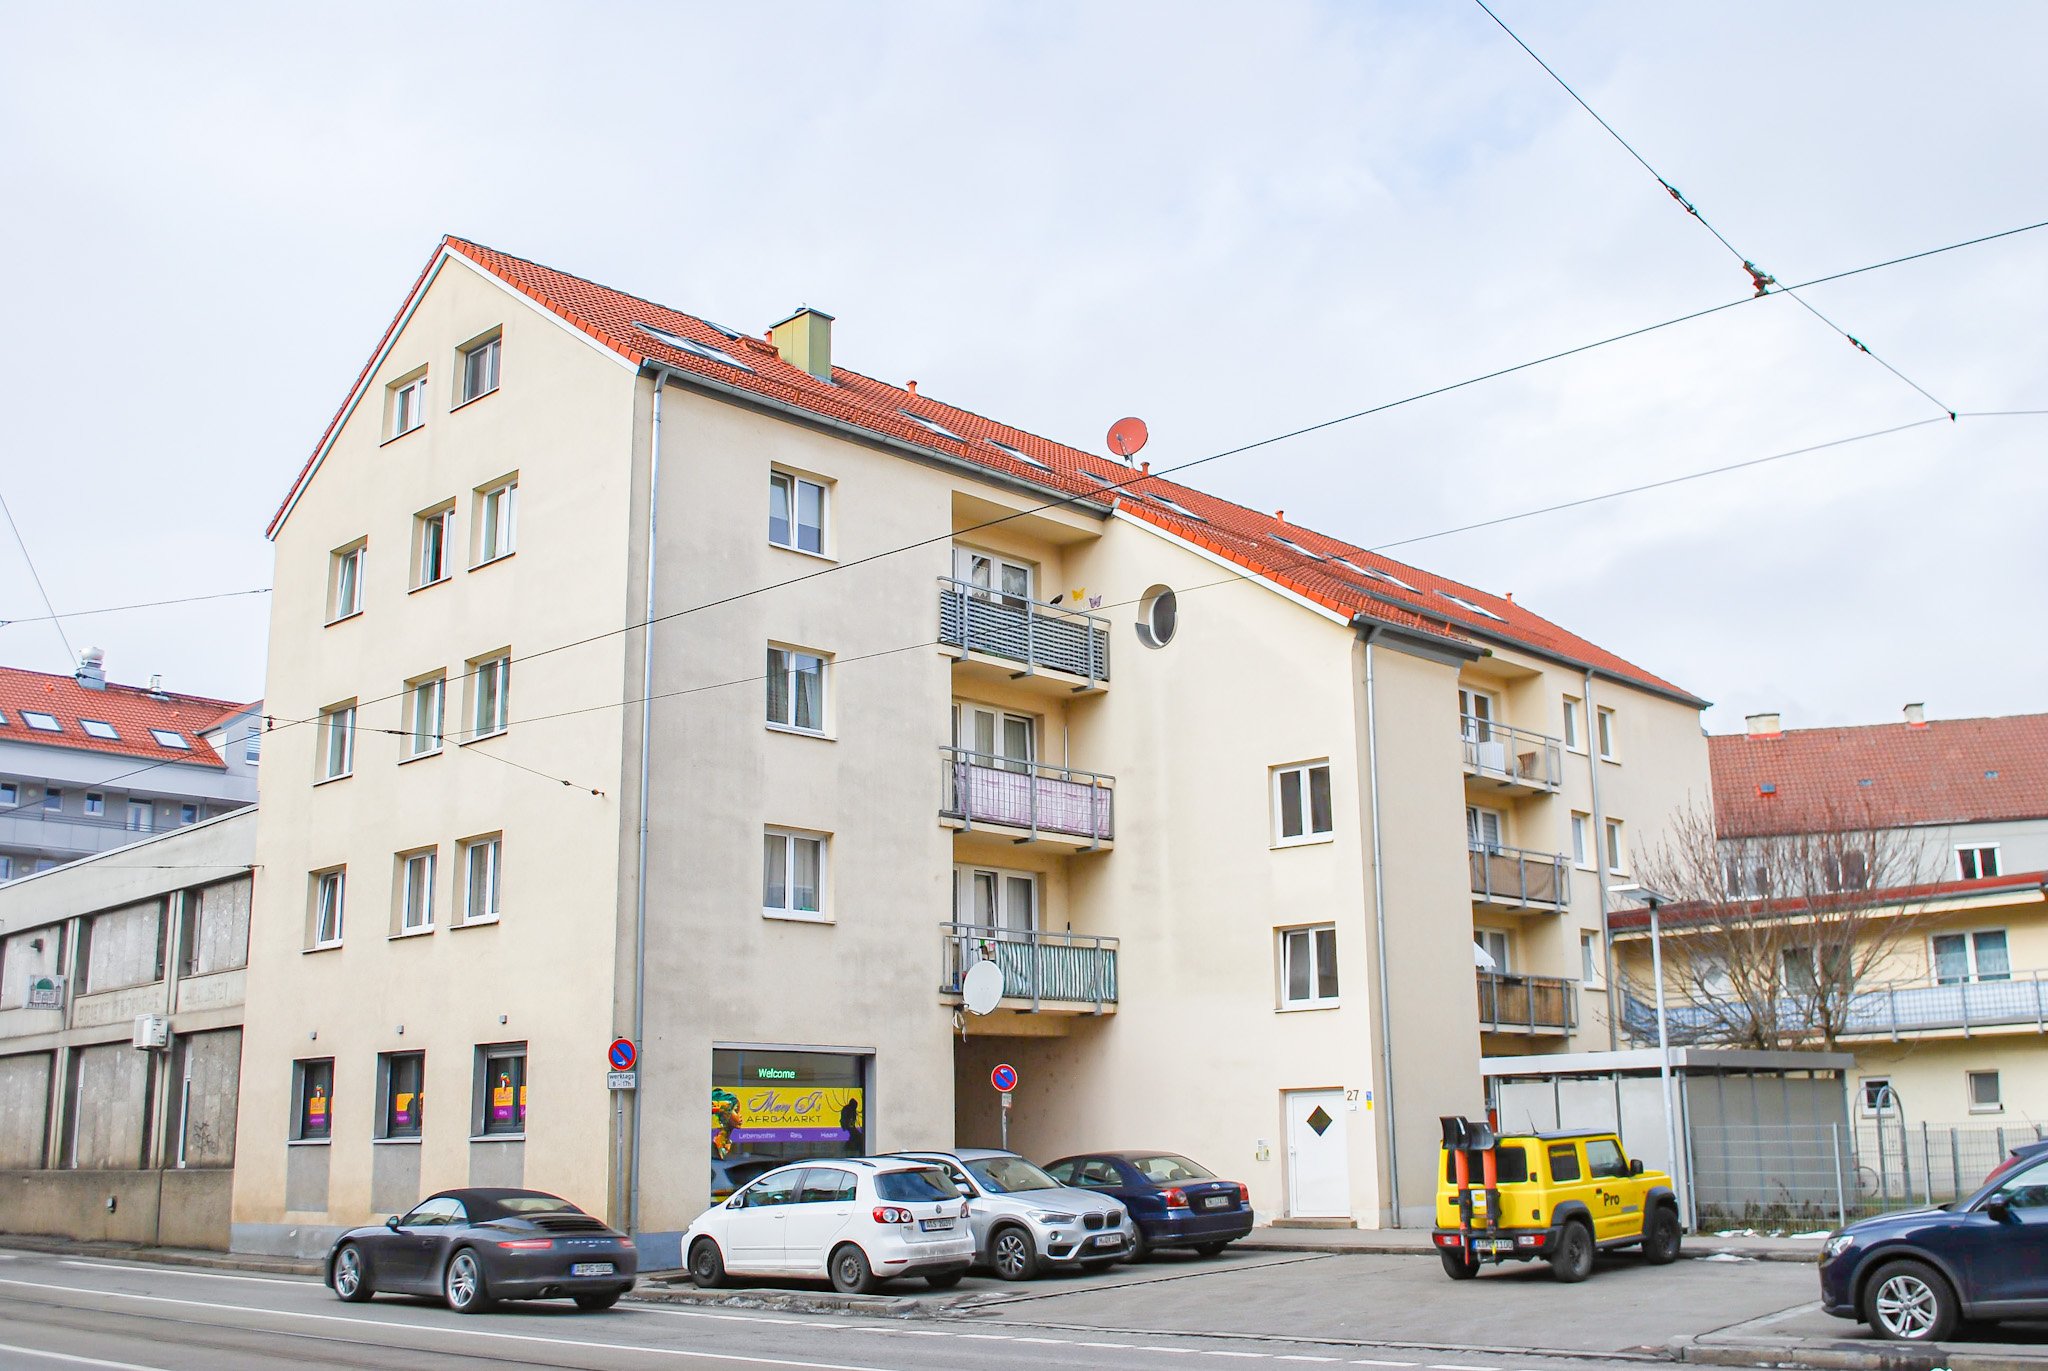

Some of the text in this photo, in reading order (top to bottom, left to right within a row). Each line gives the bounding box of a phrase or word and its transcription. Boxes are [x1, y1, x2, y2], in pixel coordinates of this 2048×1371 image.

[758, 1068, 796, 1079] Welcome
[1346, 1089, 1360, 1101] 27
[748, 1090, 791, 1119] Mary
[783, 1115, 822, 1123] MARKT
[1604, 1193, 1620, 1206] Pro
